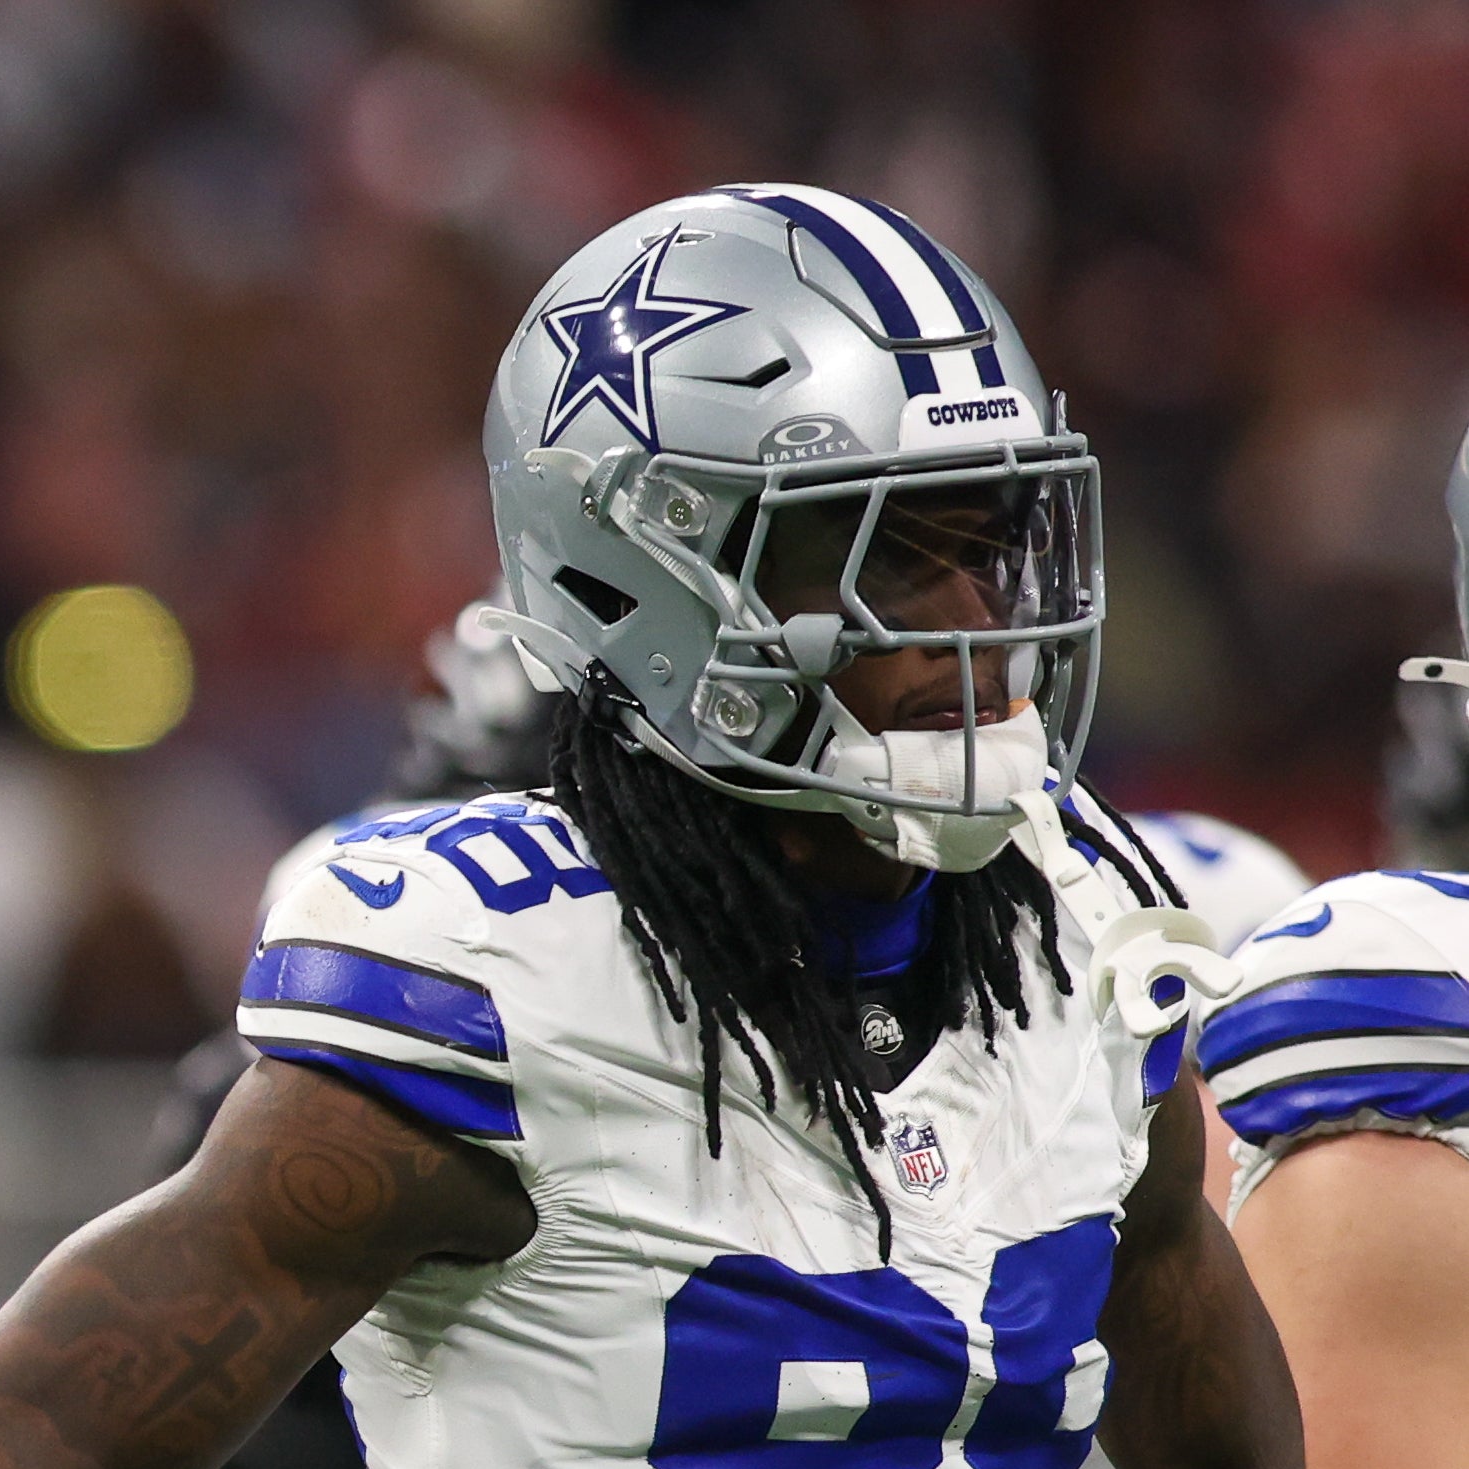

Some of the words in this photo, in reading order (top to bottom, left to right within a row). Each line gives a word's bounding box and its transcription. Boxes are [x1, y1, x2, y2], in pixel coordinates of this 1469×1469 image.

[927, 397, 1019, 426] COWBOYS
[763, 438, 850, 465] OAKLEY
[903, 1151, 942, 1183] NFL
